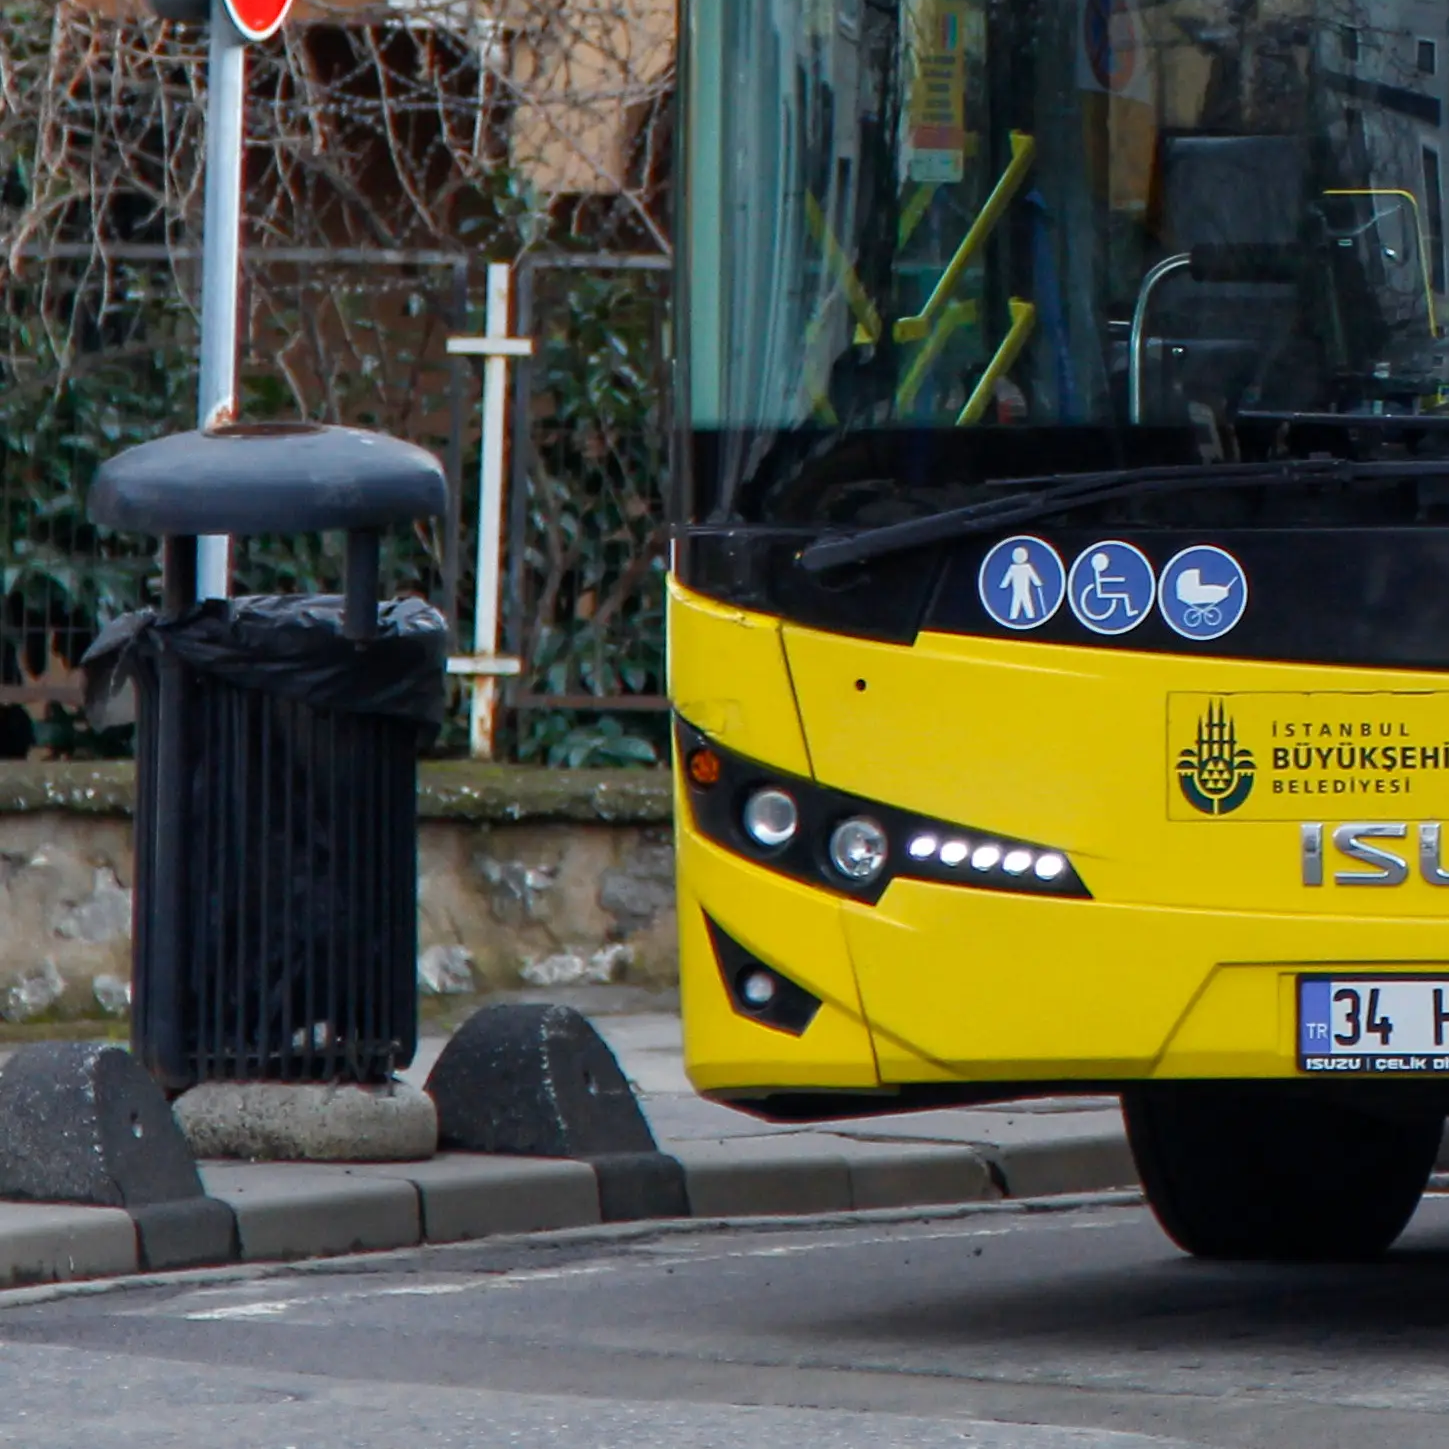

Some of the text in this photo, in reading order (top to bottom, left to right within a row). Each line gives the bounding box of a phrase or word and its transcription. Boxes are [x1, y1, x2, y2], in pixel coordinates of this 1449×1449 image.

[1271, 720, 1413, 739] İSTANBUL
[1271, 776, 1413, 794] BELEDİYESİ
[1305, 1023, 1328, 1039] TR
[1332, 988, 1393, 1047] 34
[1306, 1057, 1361, 1070] ISUZU
[1374, 1056, 1426, 1071] ÇELİK
